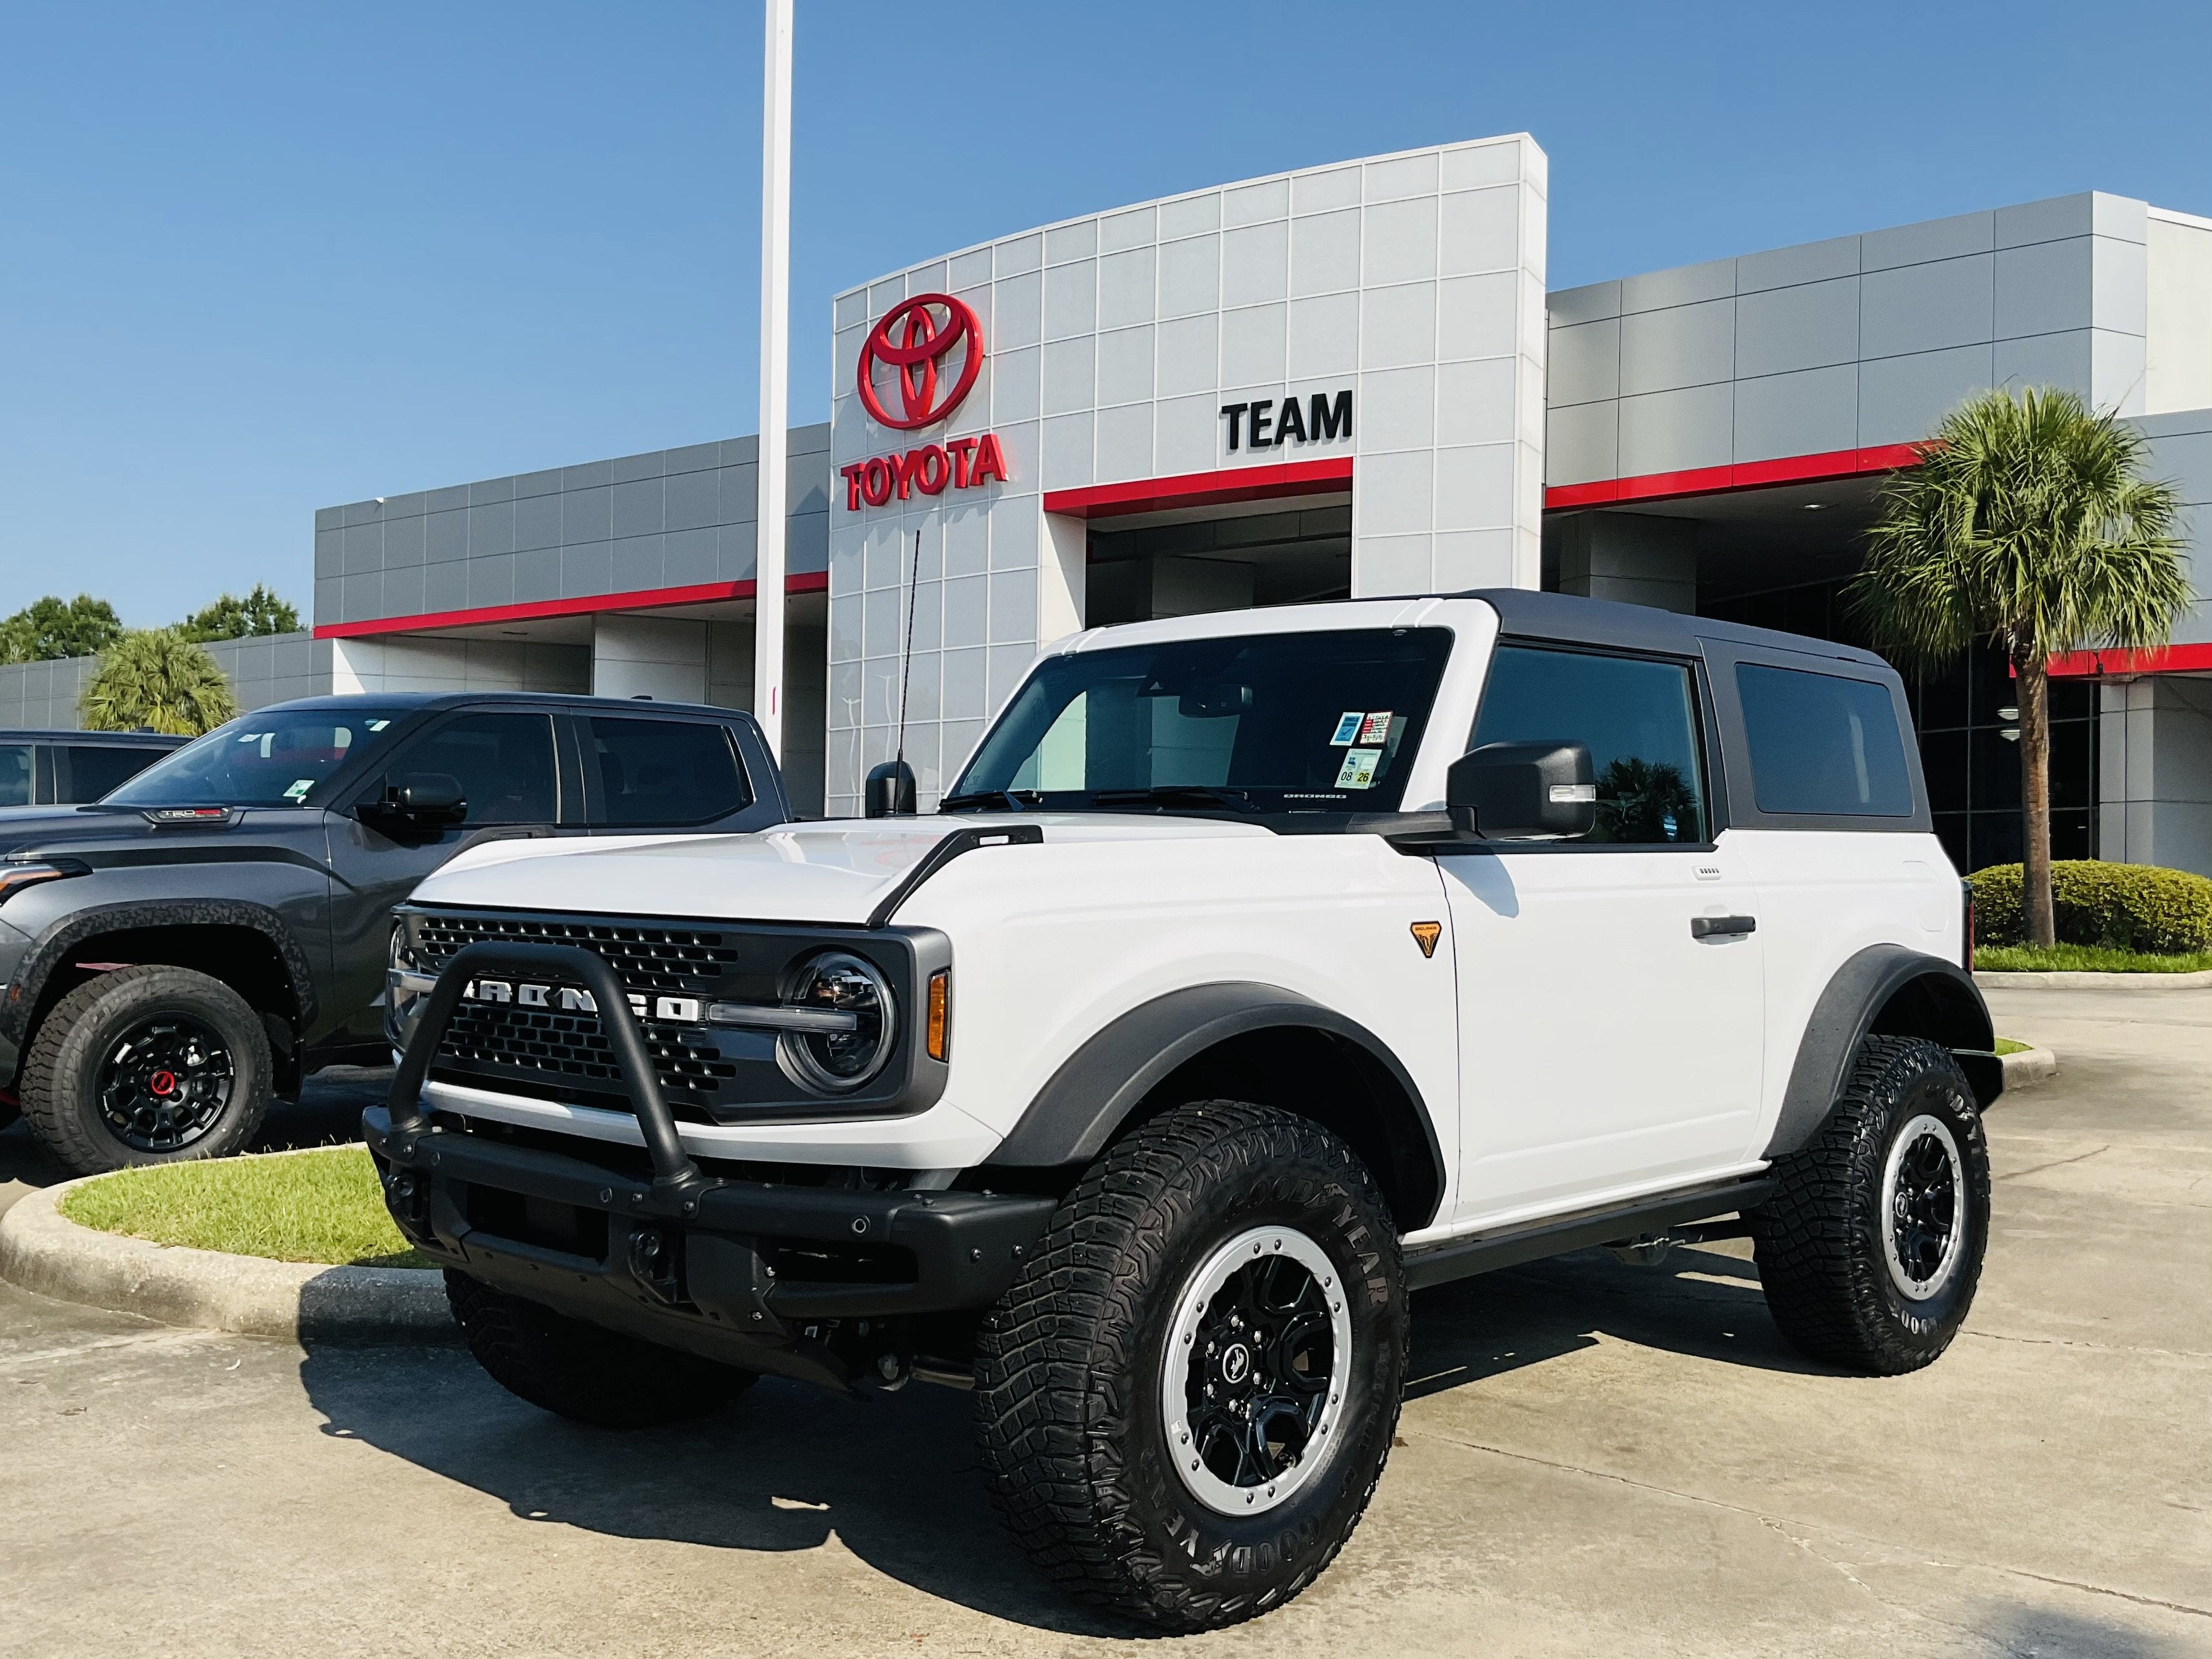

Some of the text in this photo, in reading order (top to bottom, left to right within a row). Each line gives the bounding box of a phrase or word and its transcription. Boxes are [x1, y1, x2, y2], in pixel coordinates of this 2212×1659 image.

[1221, 390, 1352, 449] TEAM
[840, 434, 1009, 511] TOYOTA
[1340, 771, 1369, 782] 08 26
